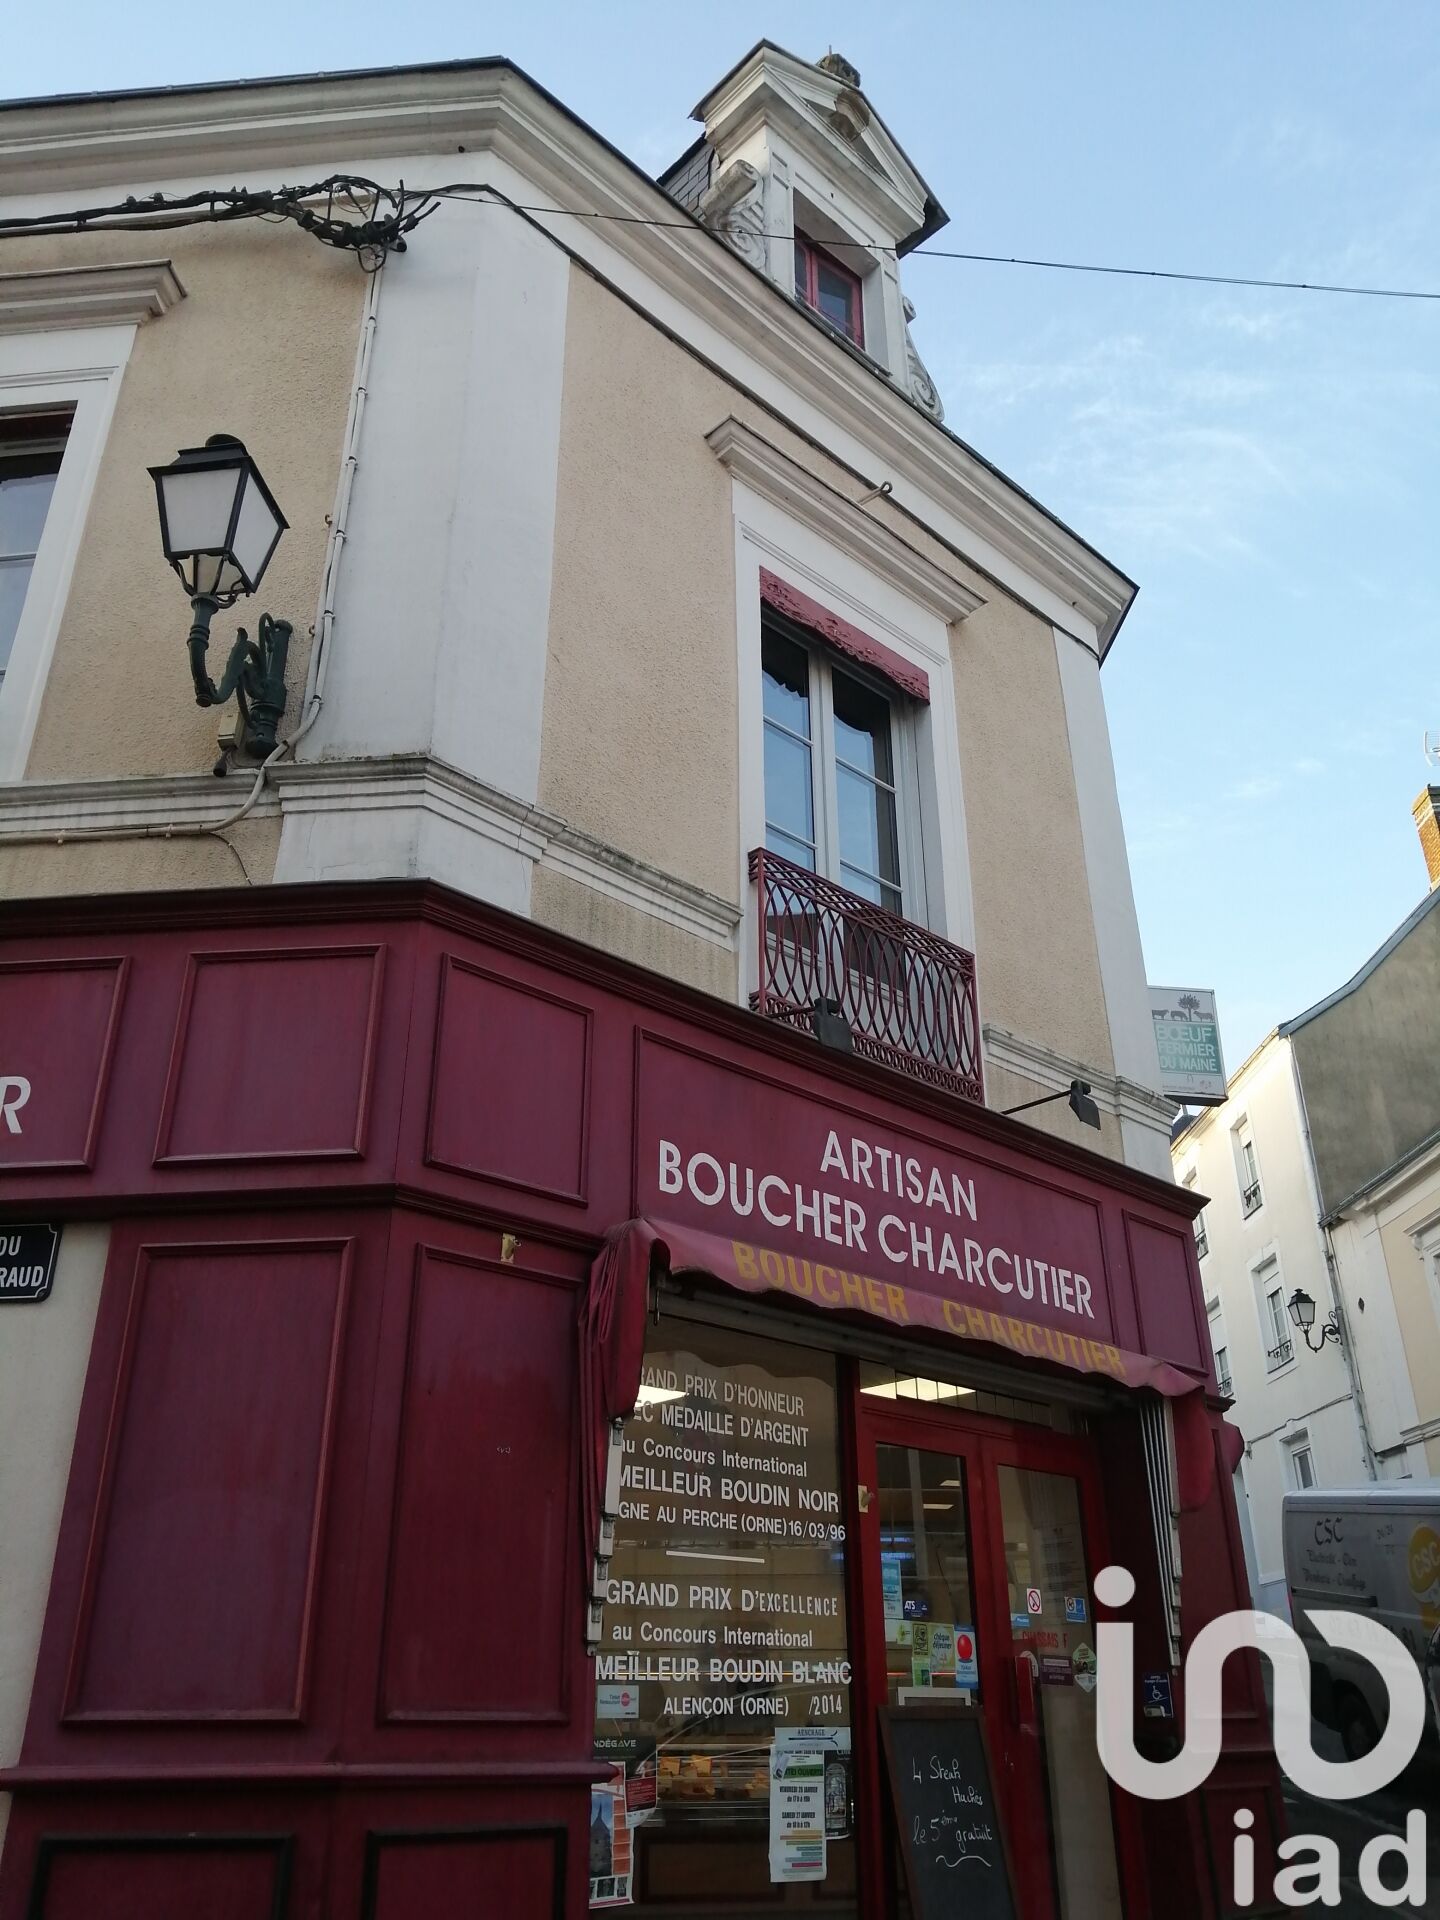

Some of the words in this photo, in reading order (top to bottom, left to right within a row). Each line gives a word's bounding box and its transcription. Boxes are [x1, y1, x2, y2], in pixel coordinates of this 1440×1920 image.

[1159, 1041, 1215, 1057] FERMIER
[1160, 1054, 1177, 1069] DU
[1180, 1057, 1217, 1072] MAINE
[820, 1130, 978, 1221] ARTISAN
[658, 1139, 868, 1253] BOUCHER
[878, 1214, 1095, 1320] CHARCUTIER
[731, 1240, 909, 1321] BOUCHER
[942, 1299, 1125, 1377] CHARCUTIER
[641, 1366, 678, 1391] AND
[685, 1374, 717, 1400] PRIX
[724, 1382, 805, 1416] D'HONNEUR
[661, 1404, 734, 1435] MEDAILLE
[740, 1416, 809, 1447] D'ARGENT
[643, 1437, 715, 1466] Concours
[722, 1450, 807, 1477] International
[721, 1478, 790, 1507] BOUDIN
[798, 1489, 839, 1513] NOIR
[656, 1505, 676, 1524] AU
[683, 1508, 737, 1530] PERCHE
[1315, 1517, 1344, 1545] CSC
[606, 1579, 679, 1607] GRAND
[689, 1586, 732, 1611] PRIX
[741, 1589, 838, 1616] D'EXCELLENCE
[612, 1624, 632, 1641] au
[640, 1621, 716, 1644] Concours
[724, 1626, 813, 1647] International
[595, 1655, 699, 1682] MEILLEUR
[710, 1658, 783, 1683] BOUDIN
[792, 1661, 852, 1684] BLANC
[663, 1697, 734, 1719] ALENÇON
[740, 1697, 789, 1717] (ORNE)
[912, 1757, 922, 1784] 4
[930, 1755, 961, 1780] Steak
[913, 1815, 926, 1845] le
[955, 1823, 993, 1853] gratuit
